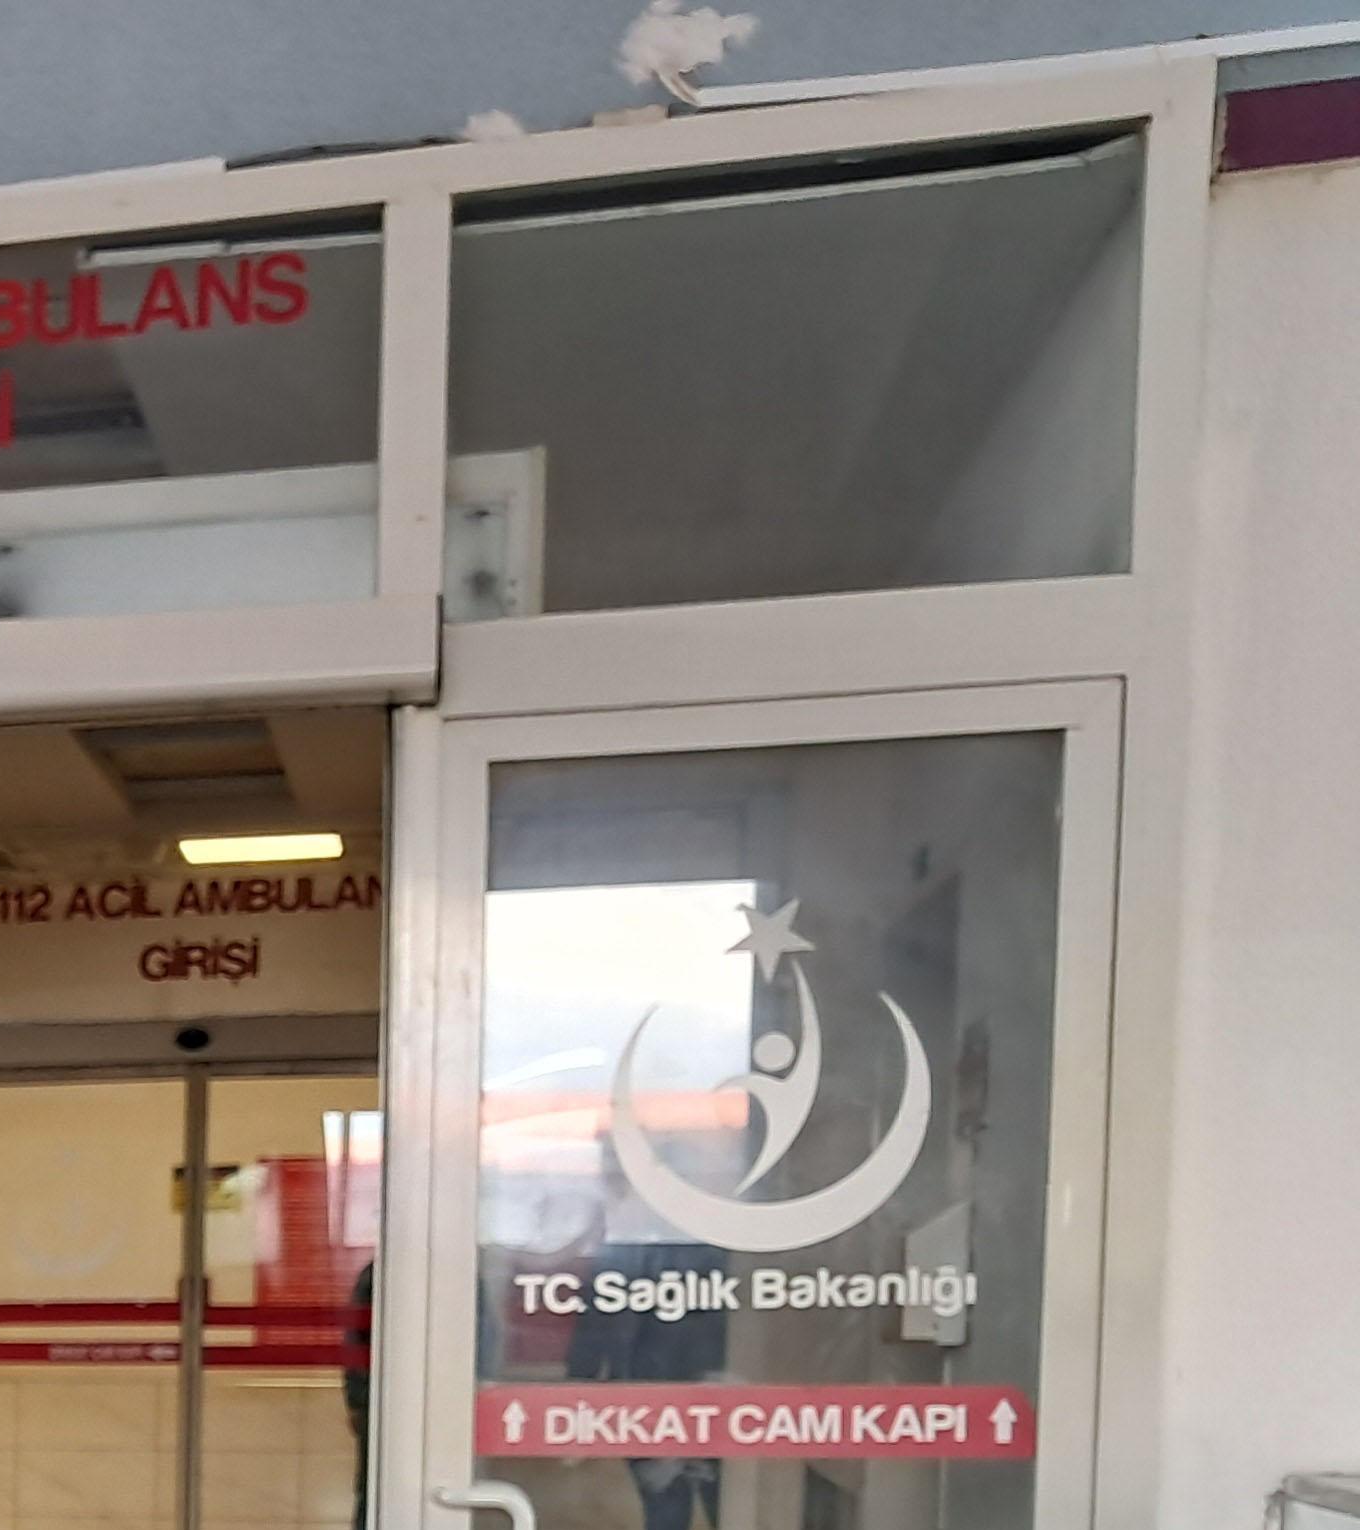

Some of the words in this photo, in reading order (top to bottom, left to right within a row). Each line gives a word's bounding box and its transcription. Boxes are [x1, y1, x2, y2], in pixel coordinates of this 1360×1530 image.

[65, 876, 162, 920] ACİL
[173, 874, 381, 915] AMBULAN
[137, 937, 260, 987] GİRİŞİ
[593, 1270, 740, 1321] Sağlık
[751, 1266, 977, 1316] Bakanlığı
[543, 1400, 721, 1444] DİKKAT
[729, 1406, 840, 1443] CAM
[850, 1406, 968, 1443] KAPI
